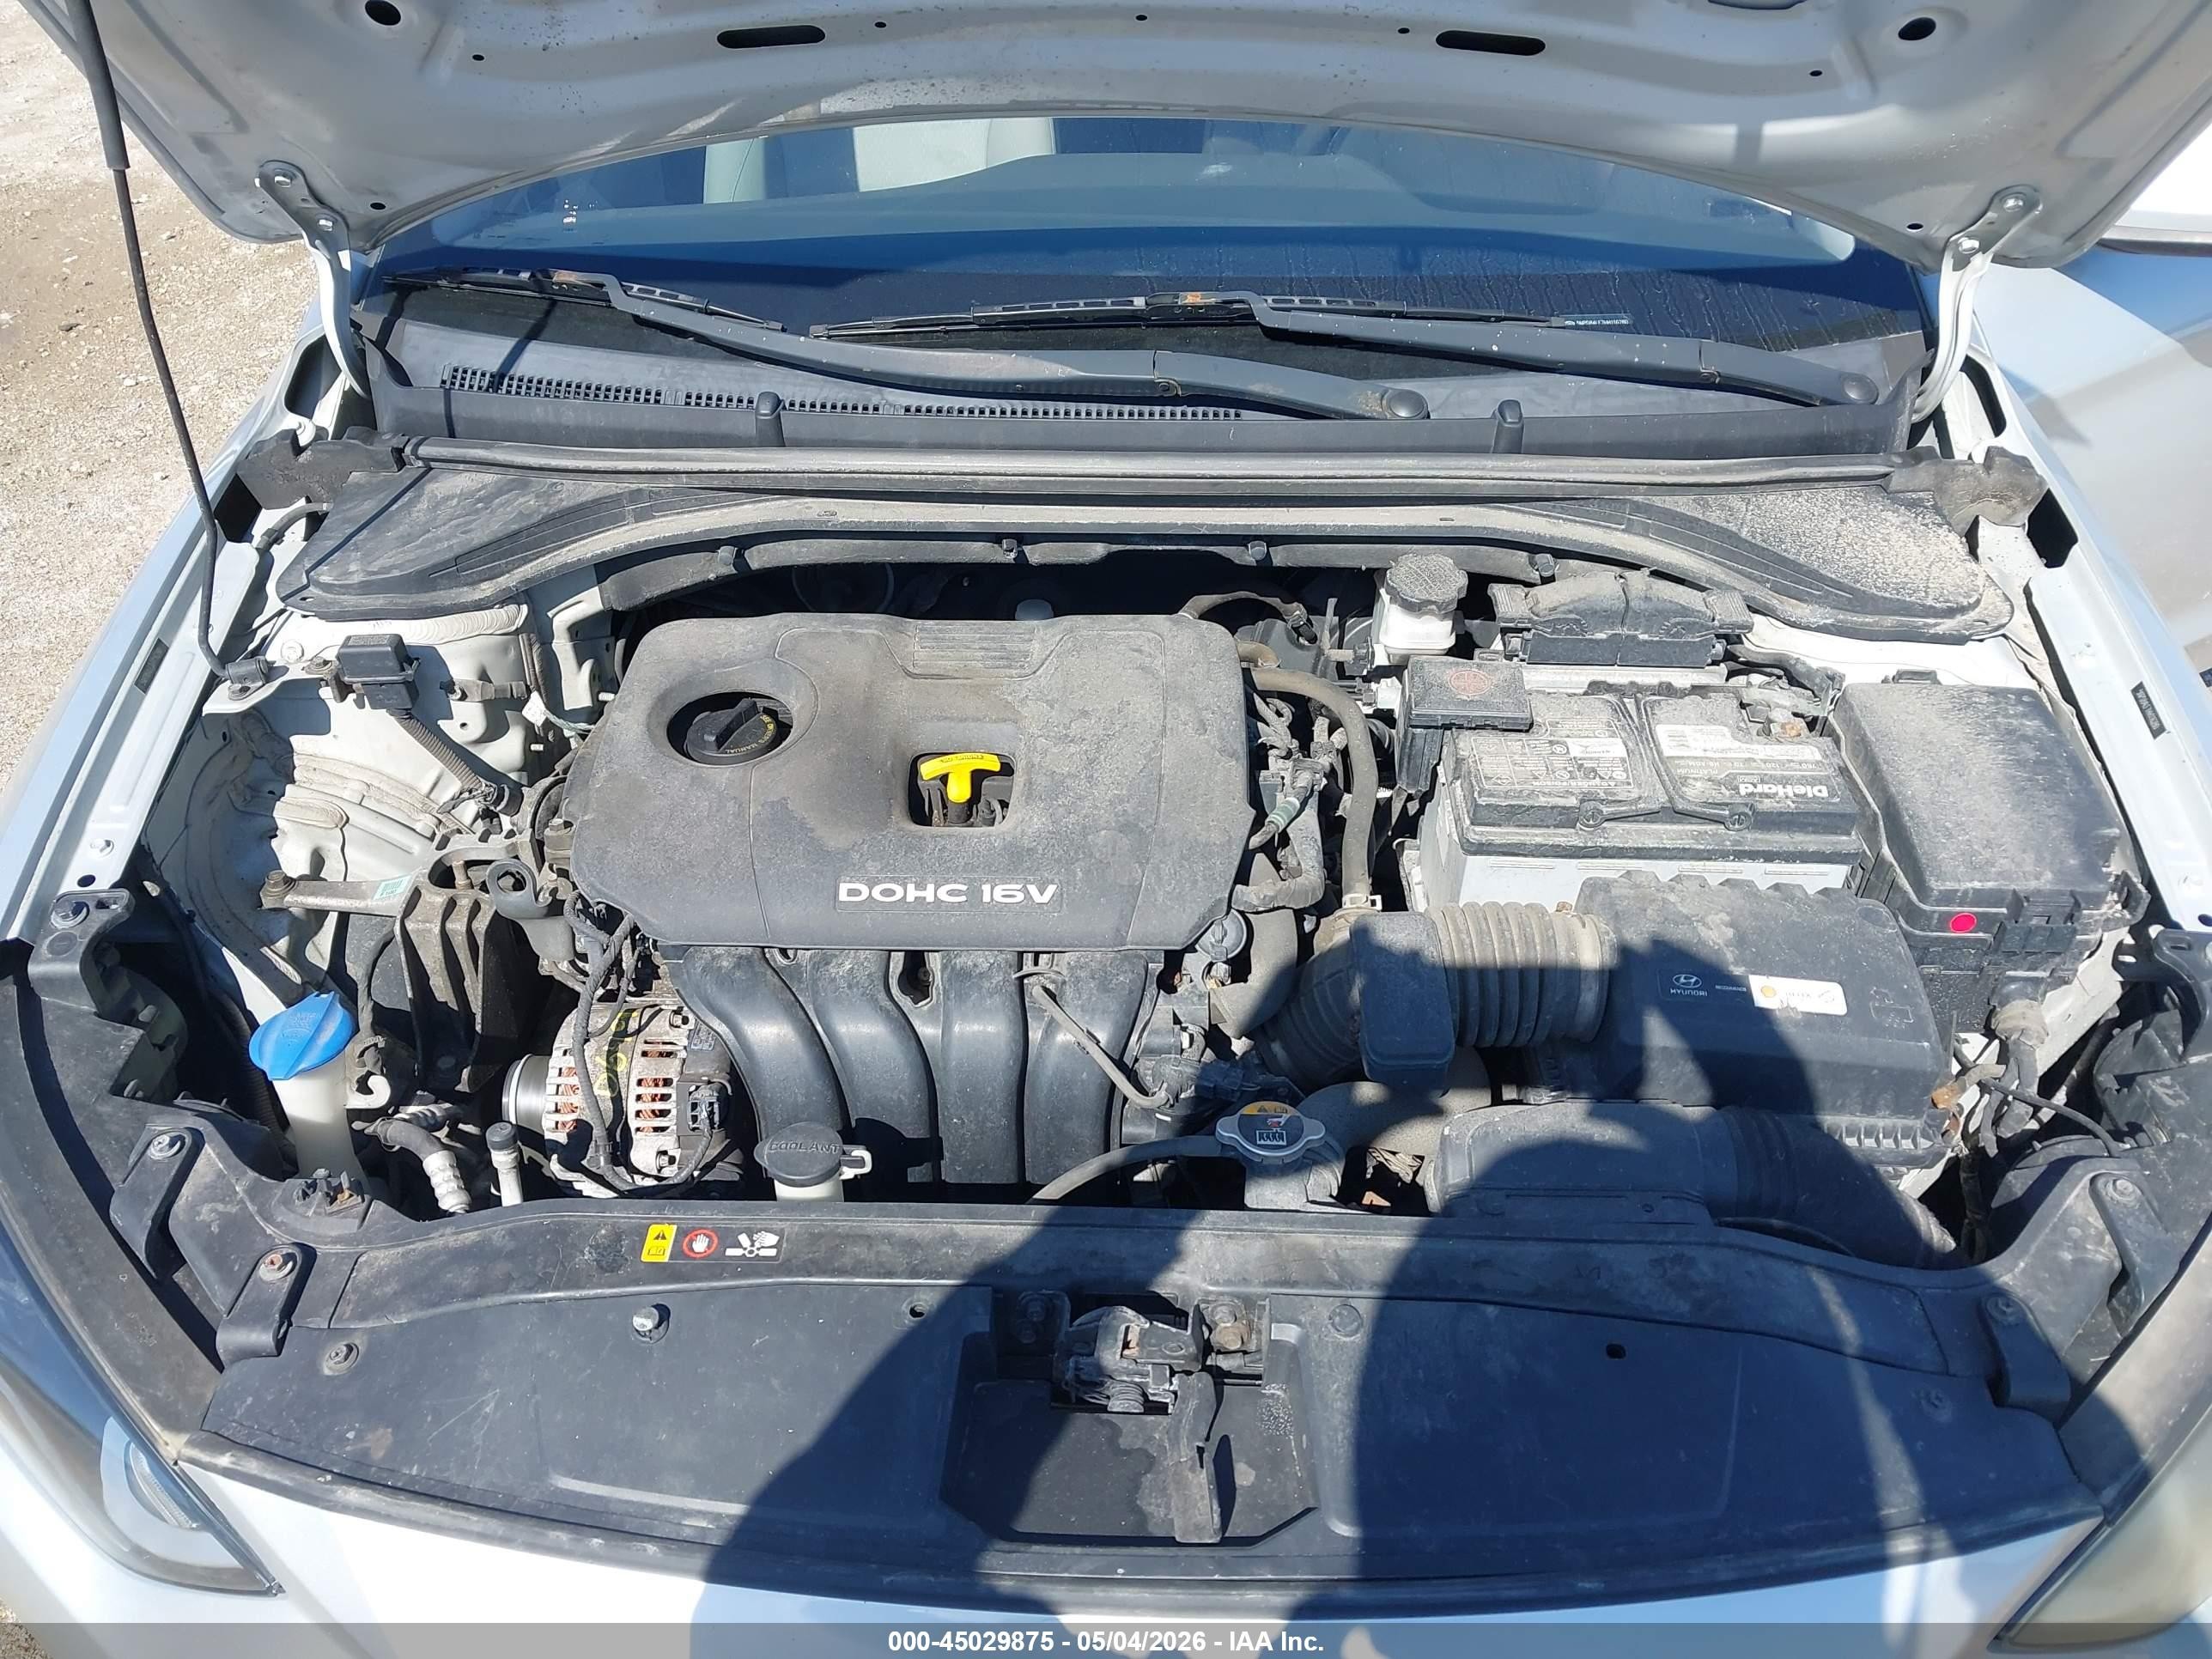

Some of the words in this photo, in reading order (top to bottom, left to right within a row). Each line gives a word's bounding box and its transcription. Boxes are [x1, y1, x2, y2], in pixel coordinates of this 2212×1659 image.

[1739, 783, 1829, 798] DieHard
[839, 883, 968, 902] DOHC
[981, 884, 1058, 904] 16V
[1669, 988, 1708, 997] HYUNDAI
[769, 1140, 839, 1154] COOLANT
